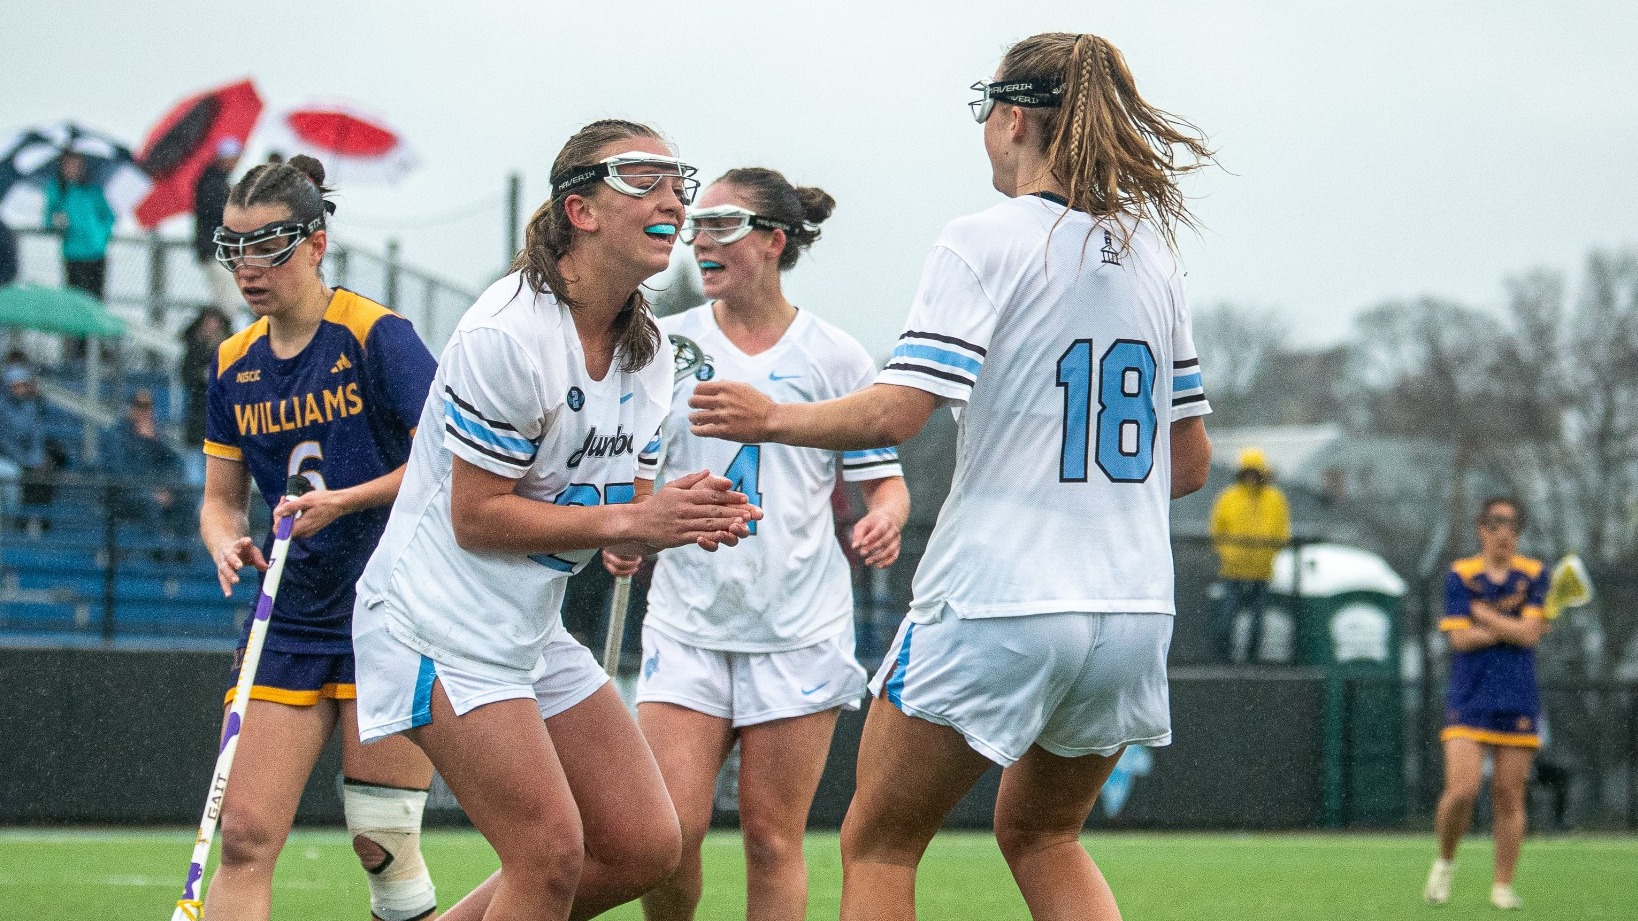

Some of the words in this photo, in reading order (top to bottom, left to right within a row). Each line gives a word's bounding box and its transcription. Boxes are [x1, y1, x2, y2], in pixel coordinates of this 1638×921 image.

[558, 170, 596, 191] MAVERIK
[307, 216, 323, 233] STX
[233, 382, 364, 437] WILLIAMS
[1055, 338, 1158, 484] 18
[286, 440, 328, 492] 6
[723, 444, 763, 536] 4
[207, 773, 227, 820] GAIT
